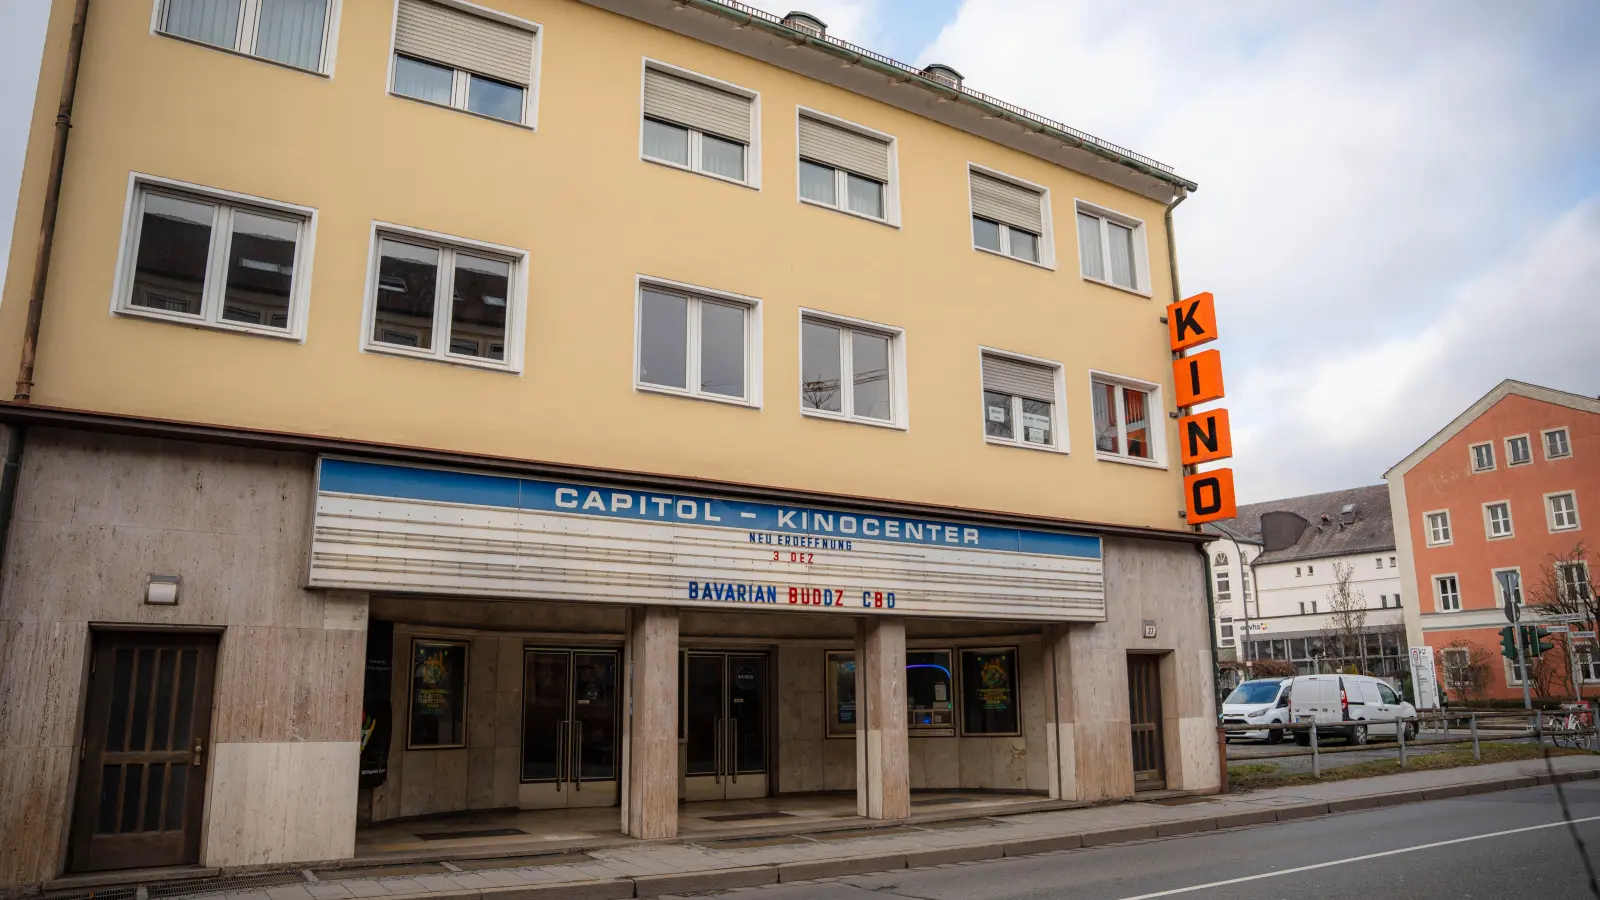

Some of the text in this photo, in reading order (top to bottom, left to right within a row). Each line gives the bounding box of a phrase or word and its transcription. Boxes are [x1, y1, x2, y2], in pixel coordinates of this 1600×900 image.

[1174, 299, 1222, 516] KINO
[555, 487, 721, 522] CAPITOL
[777, 509, 980, 545] KINOCENTER
[749, 532, 772, 545] NEU
[773, 551, 815, 564] 3 DEZ
[688, 581, 896, 609] BAVARIAN BUDDZ CBD
[1147, 627, 1154, 635] 27
[1248, 623, 1261, 631] vhs
